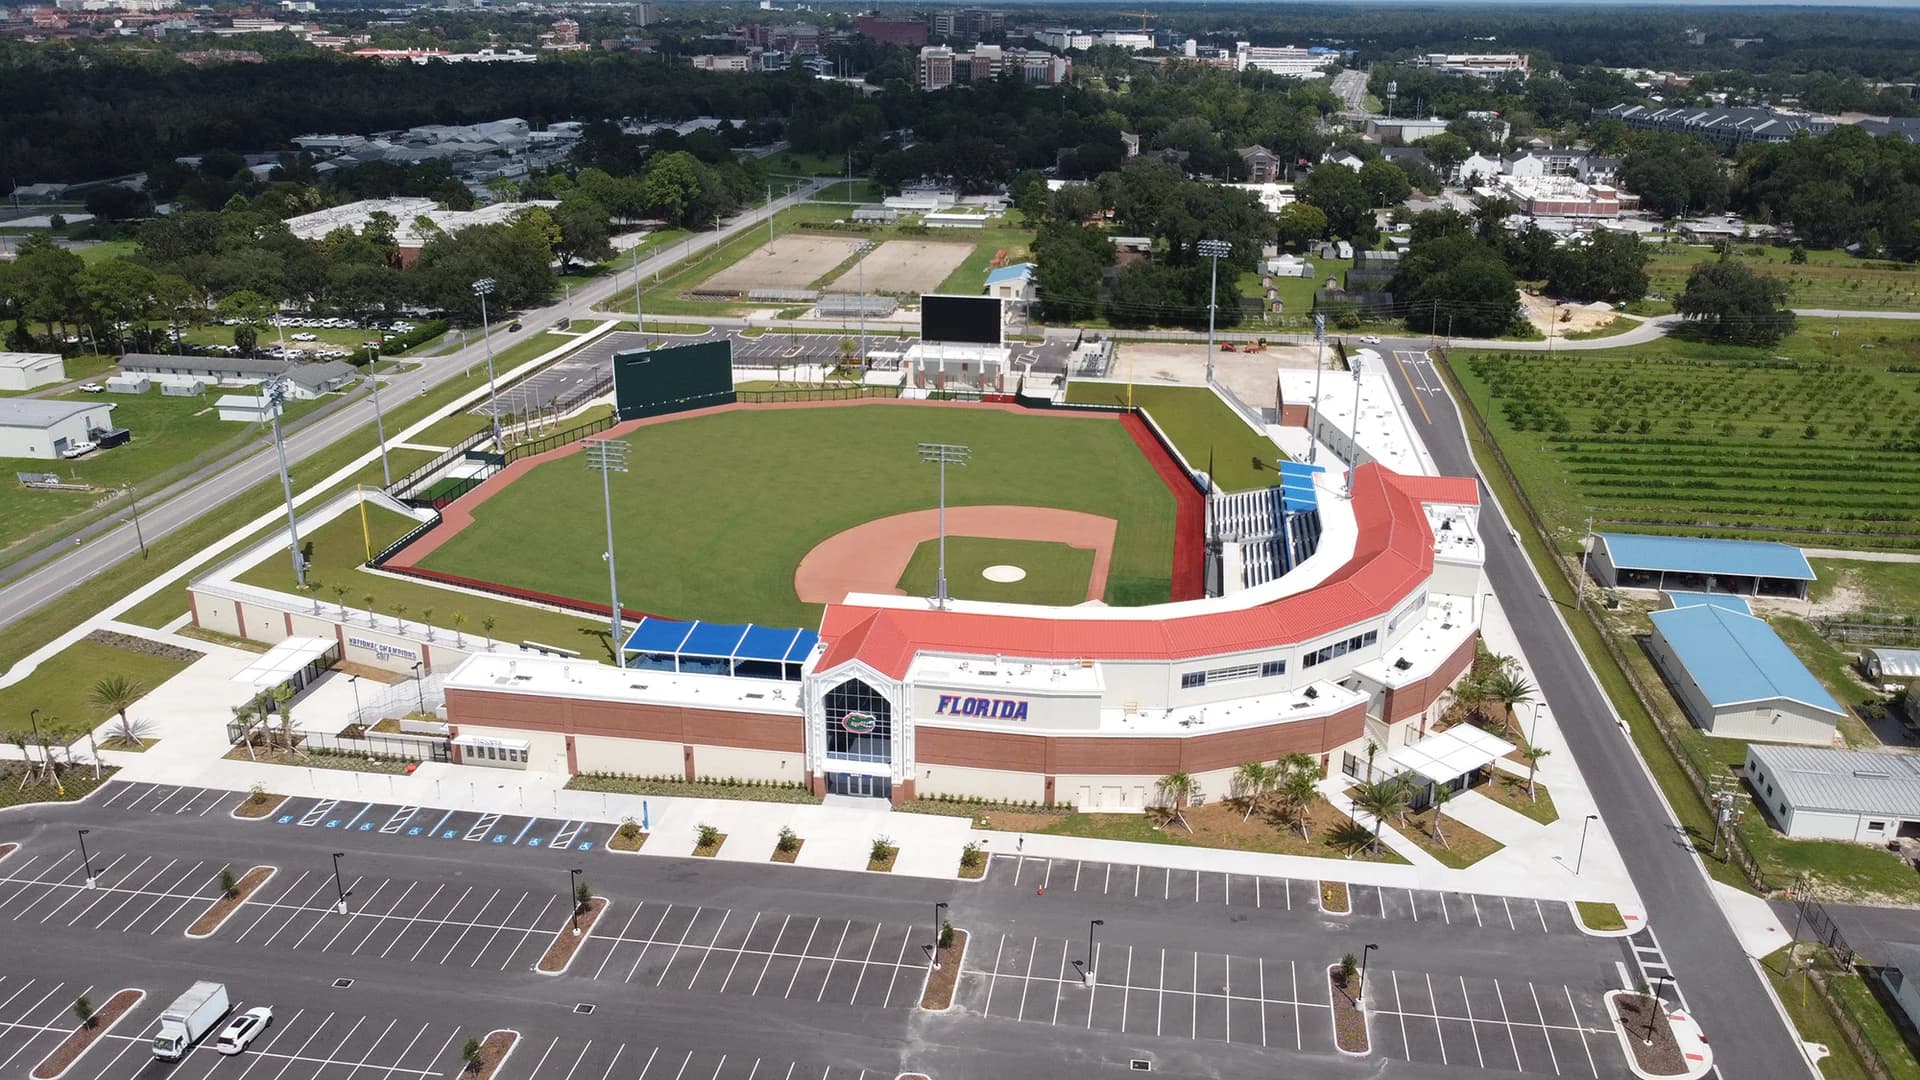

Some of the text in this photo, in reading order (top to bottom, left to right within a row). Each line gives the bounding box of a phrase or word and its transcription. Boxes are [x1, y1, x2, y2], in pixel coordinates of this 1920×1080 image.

[348, 637, 417, 660] NATIONAL CHAMPIONS
[935, 695, 1028, 720] FLORIDA
